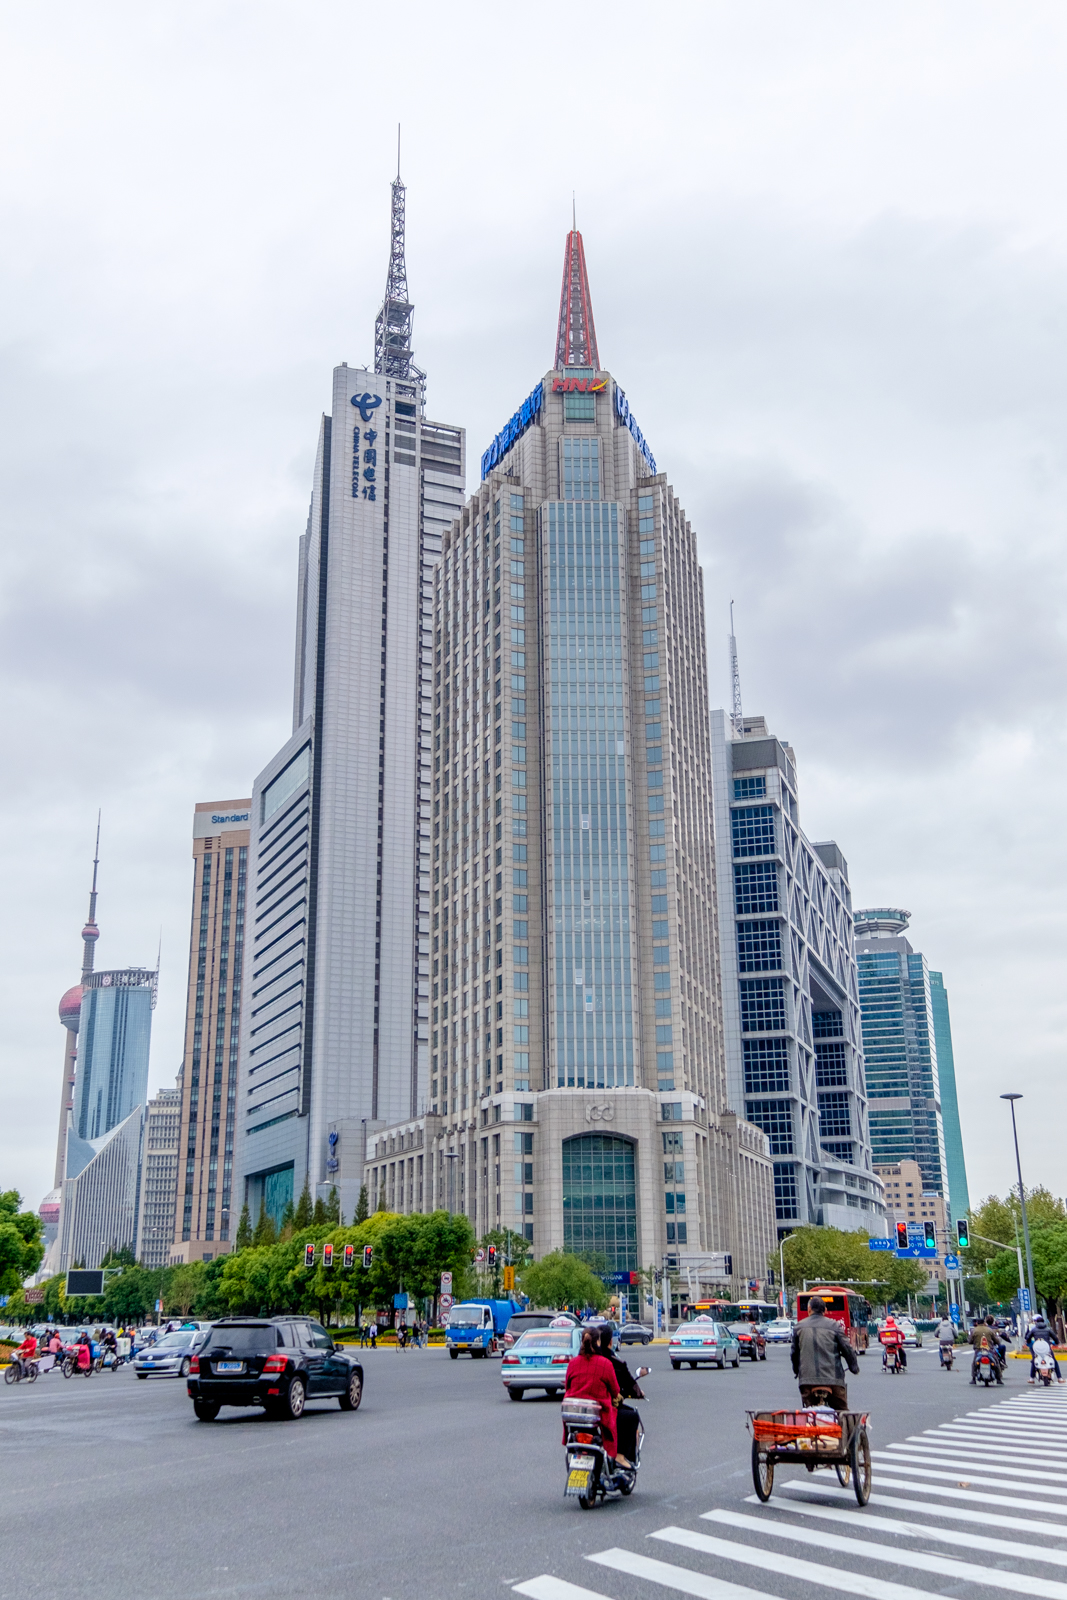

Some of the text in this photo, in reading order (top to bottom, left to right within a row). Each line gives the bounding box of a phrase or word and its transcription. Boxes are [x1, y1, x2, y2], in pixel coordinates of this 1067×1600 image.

[552, 377, 606, 392] HNA
[352, 455, 360, 498] TELECOM
[362, 427, 378, 501] 中国电信
[211, 812, 249, 824] Standard
